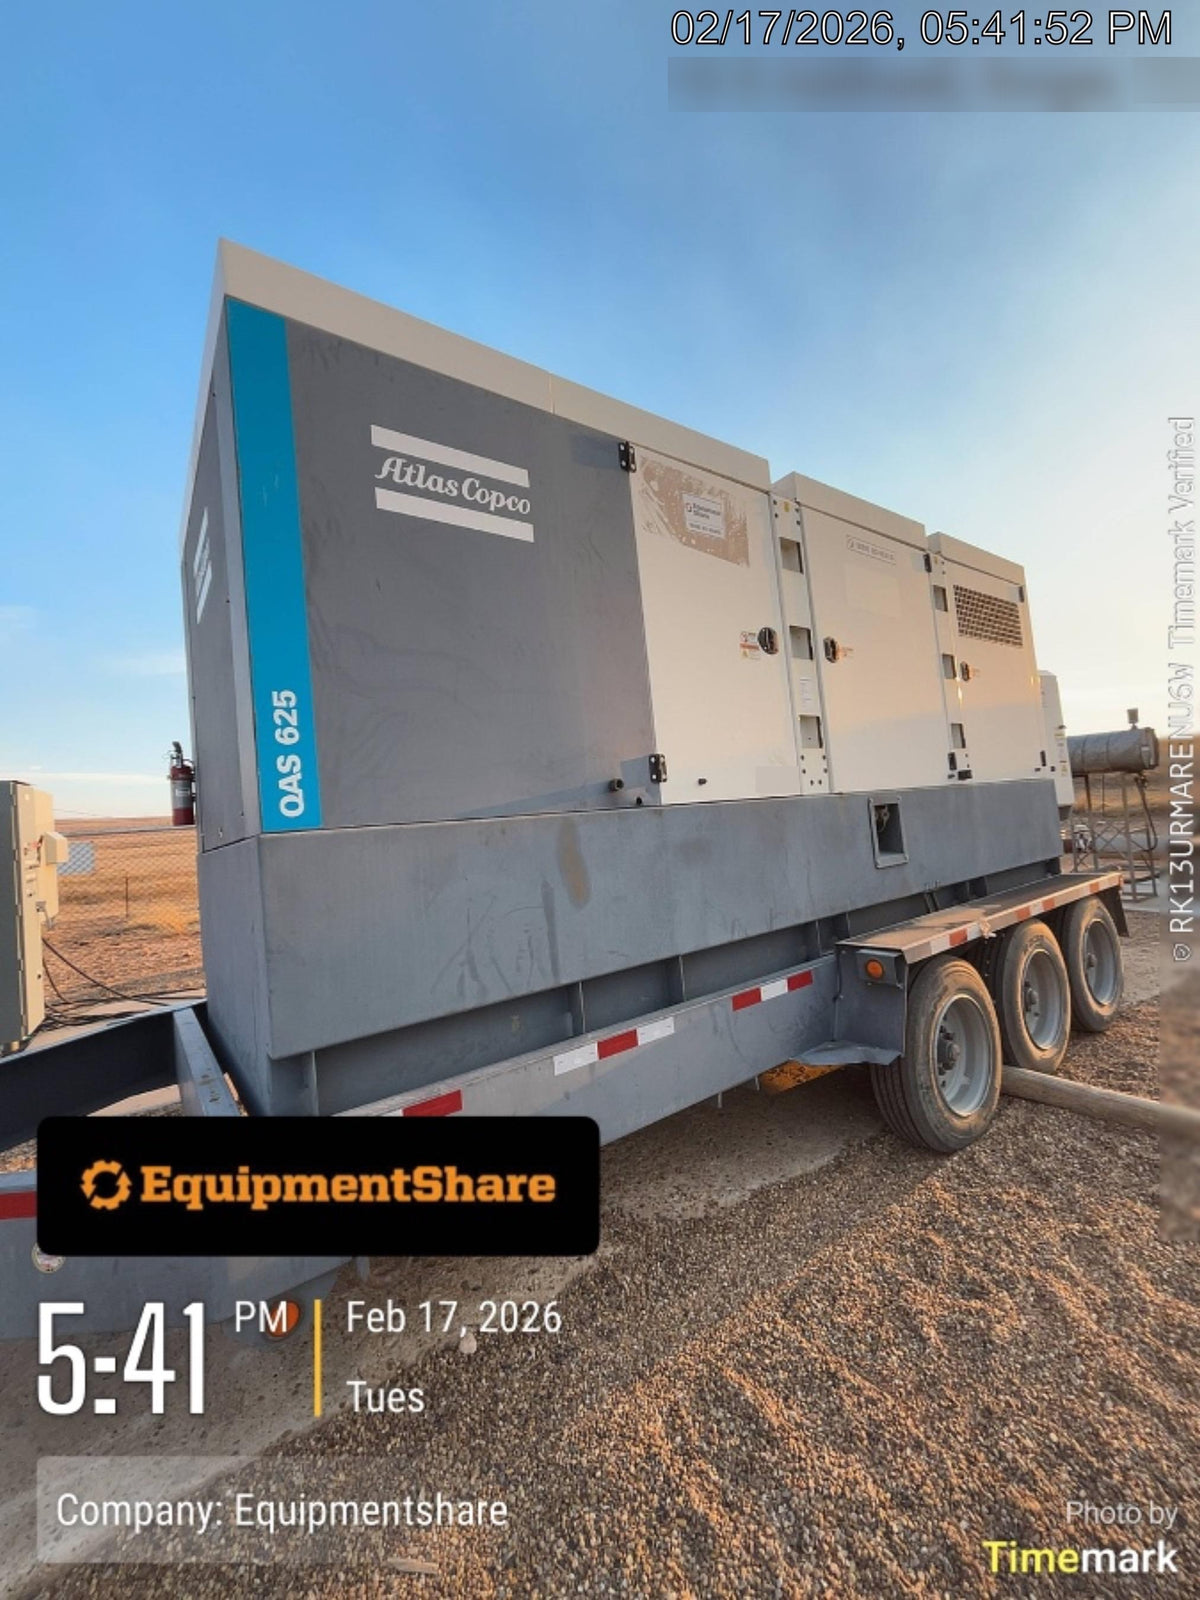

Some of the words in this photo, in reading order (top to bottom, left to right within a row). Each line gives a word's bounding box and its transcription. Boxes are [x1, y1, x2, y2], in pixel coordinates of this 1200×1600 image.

[374, 456, 459, 497] Atlas
[461, 477, 531, 515] Copco
[271, 689, 300, 746] 625
[276, 754, 305, 818] QAS
